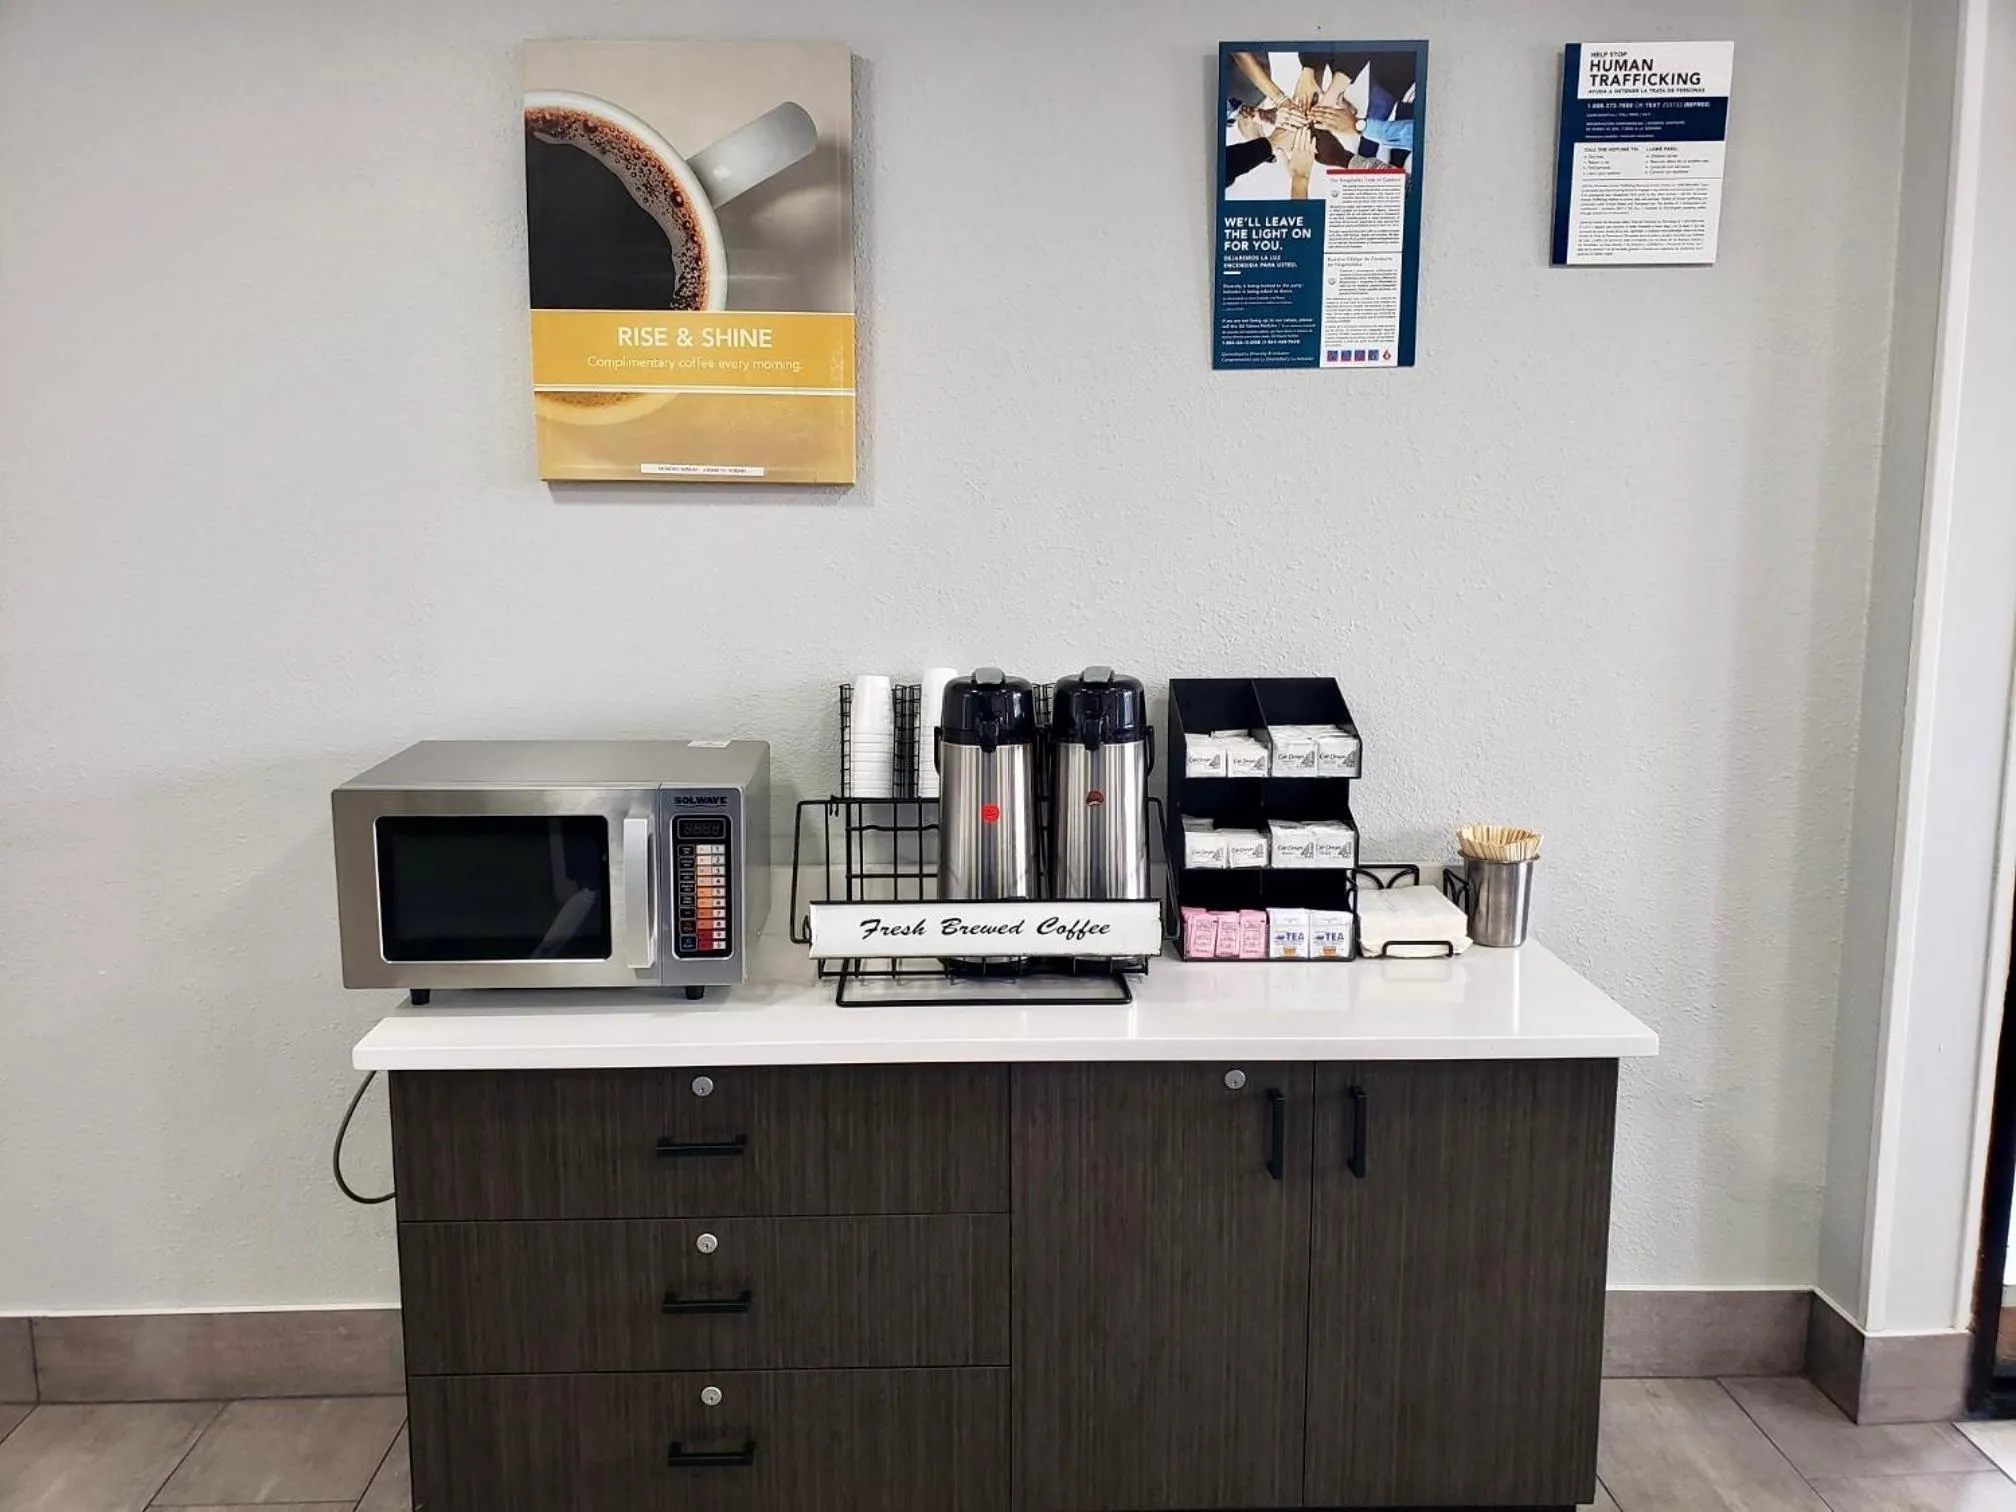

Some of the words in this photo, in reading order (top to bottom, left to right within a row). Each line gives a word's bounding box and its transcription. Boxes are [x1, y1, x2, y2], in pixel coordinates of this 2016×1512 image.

[1590, 58, 1654, 72] HUMAN
[1590, 72, 1701, 86] TRAFFICKING
[1224, 217, 1261, 227] WE'LL
[1265, 216, 1304, 226] LEAVE
[1224, 229, 1248, 239] THE
[1252, 229, 1288, 239] LIGHT
[1291, 228, 1311, 239] ON
[1224, 241, 1249, 251] FOR
[1253, 241, 1283, 250] YOU.
[617, 327, 668, 347] RISE
[676, 327, 694, 347] &
[701, 328, 772, 348] SHINE
[587, 355, 676, 371] Complimentary
[679, 356, 715, 369] coffee
[718, 359, 749, 371] every
[753, 360, 804, 373] morning.
[675, 796, 728, 804] SOLWAVE
[859, 917, 928, 941] Fresh
[940, 916, 1025, 937] Brewed
[1036, 916, 1111, 942] Coffee
[1286, 932, 1304, 941] TEA
[1325, 932, 1344, 941] TEA
